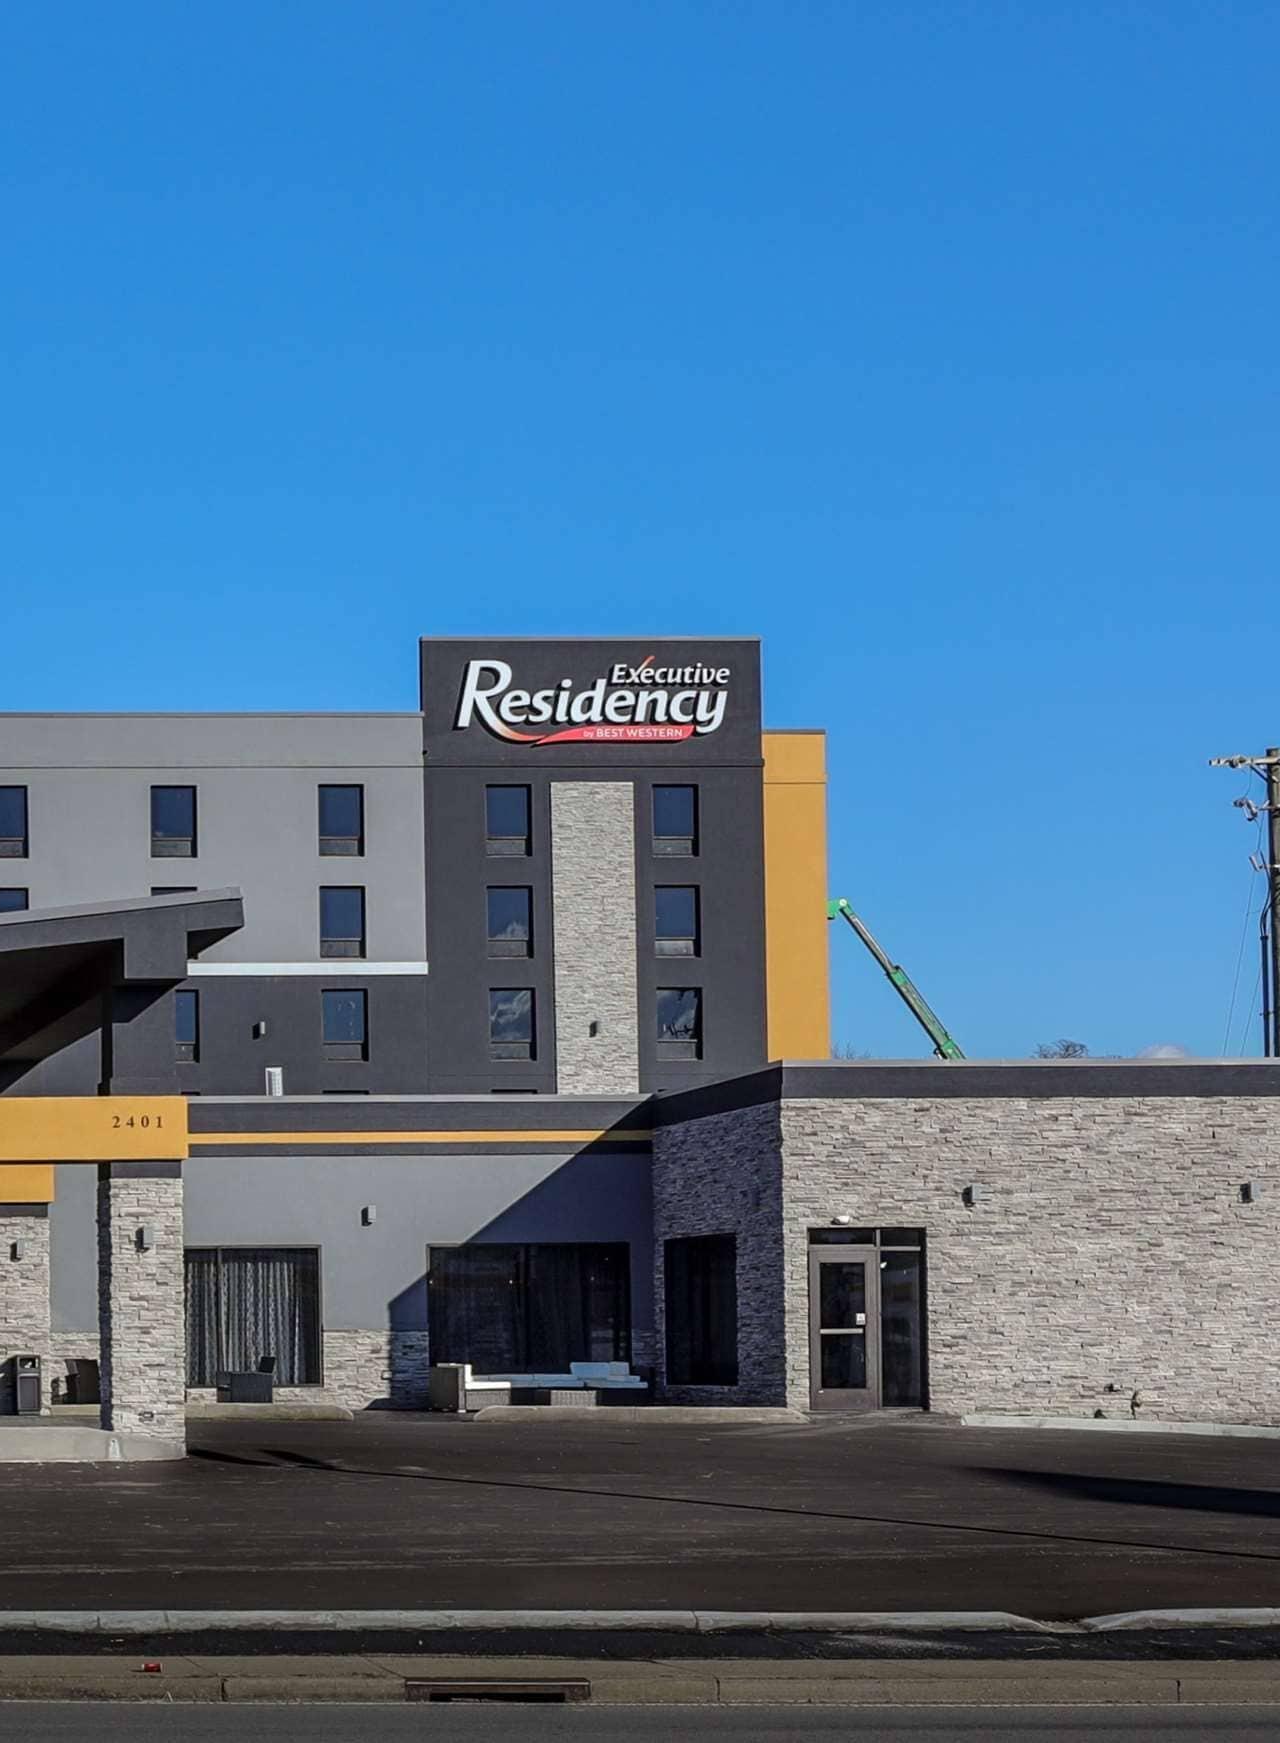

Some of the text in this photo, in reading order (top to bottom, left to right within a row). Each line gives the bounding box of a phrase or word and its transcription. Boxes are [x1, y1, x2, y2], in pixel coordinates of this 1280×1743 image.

[611, 659, 731, 684] Executive
[456, 659, 729, 740] Residency
[583, 728, 683, 739] by BEST WESTERN
[111, 1115, 164, 1129] 2401
